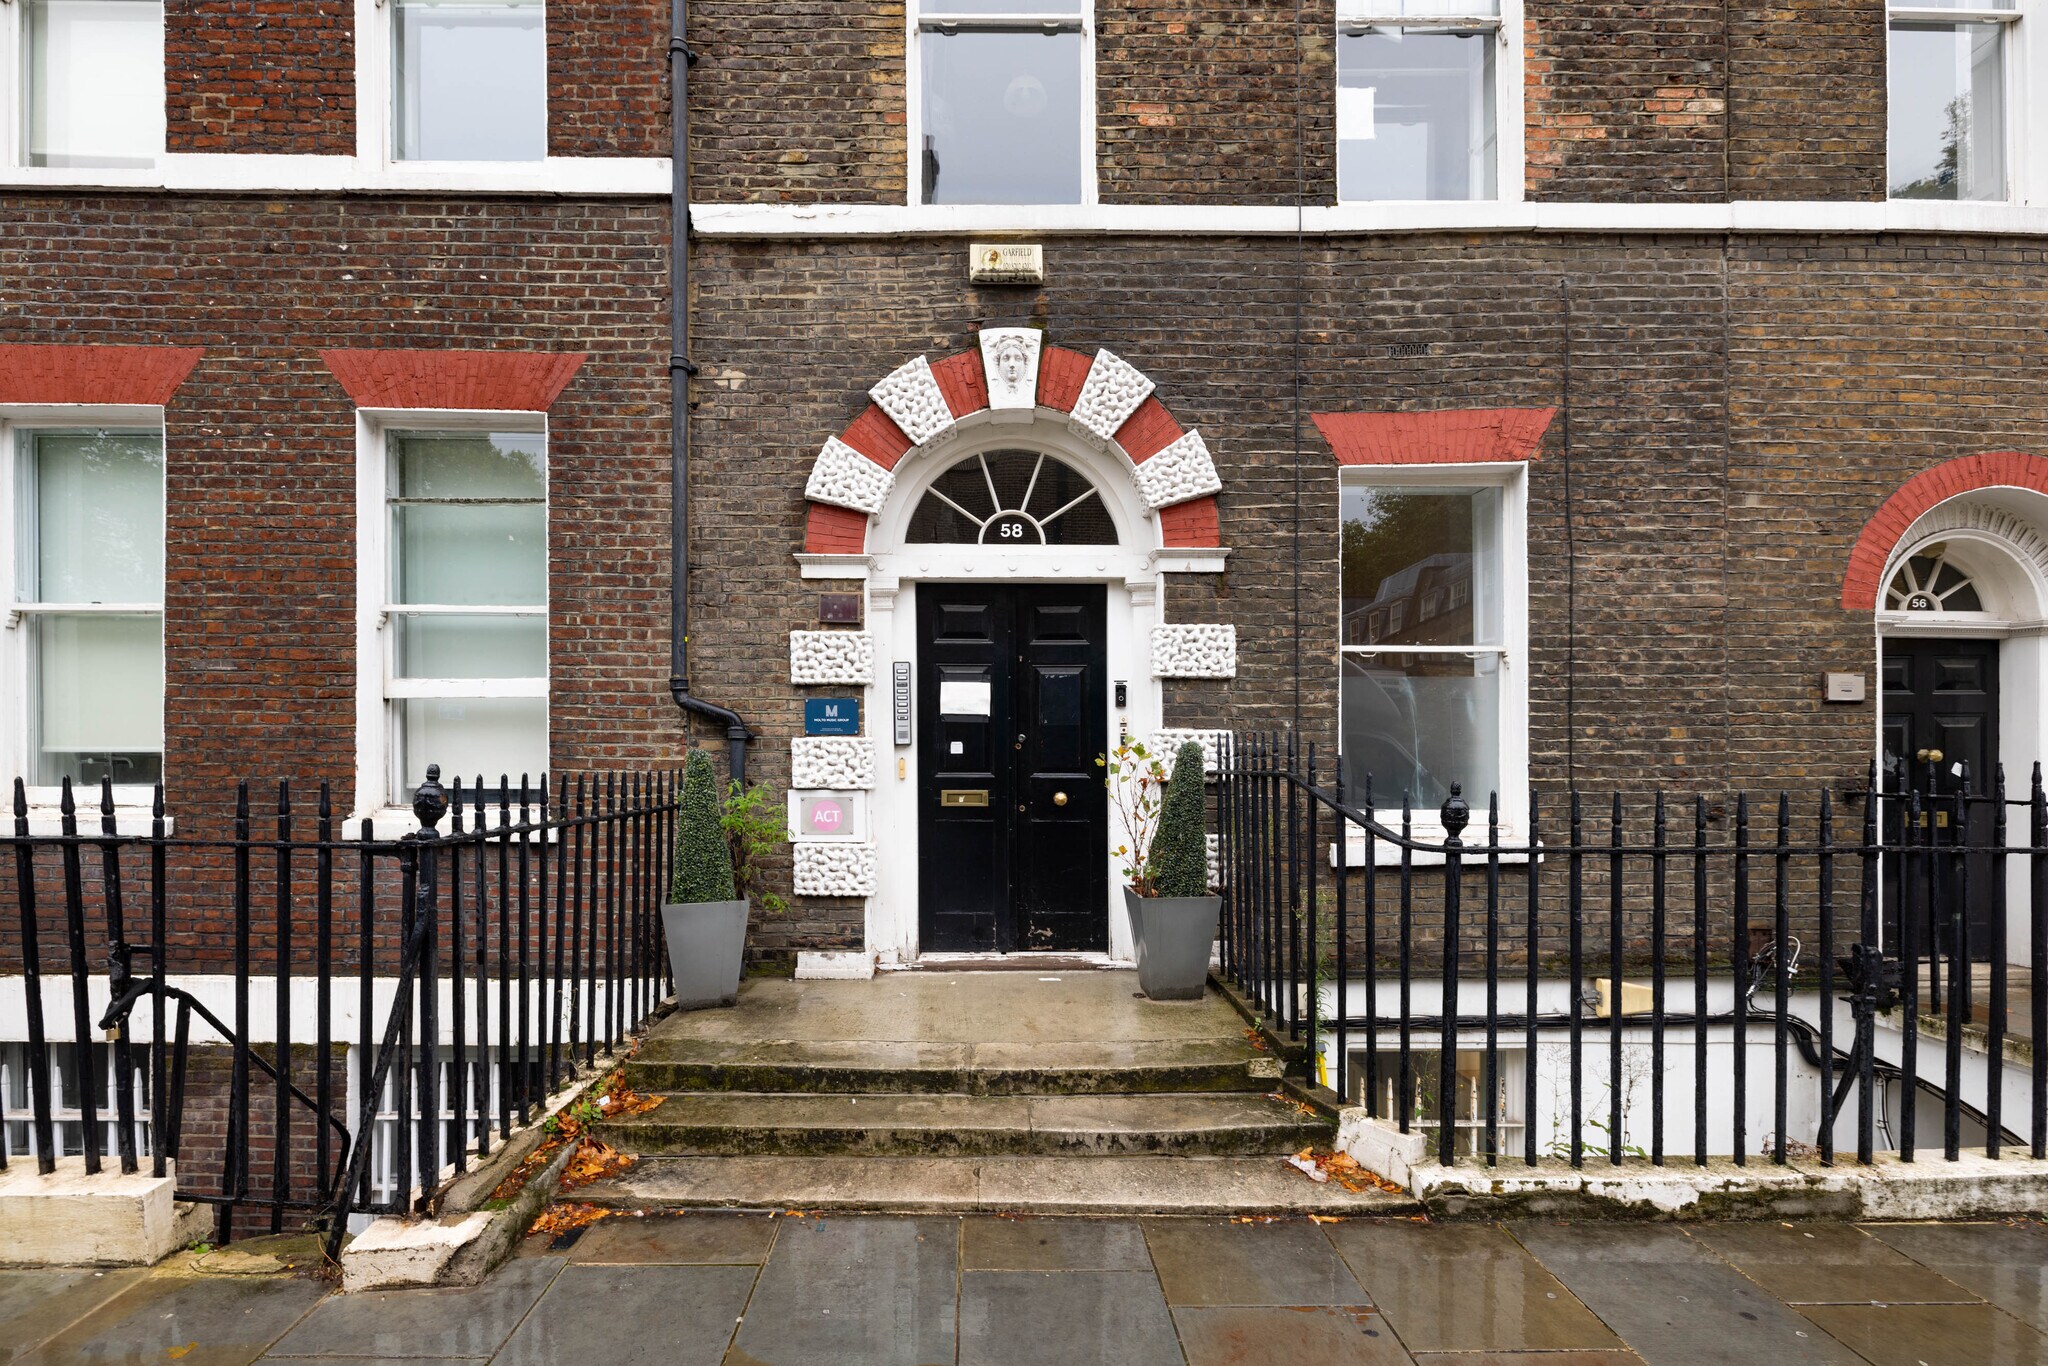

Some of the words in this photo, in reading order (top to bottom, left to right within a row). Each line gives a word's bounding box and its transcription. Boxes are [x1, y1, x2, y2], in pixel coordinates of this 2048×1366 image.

[1003, 248, 1032, 256] GARFIELD
[1000, 523, 1023, 538] 58
[1911, 598, 1927, 608] 56
[825, 704, 838, 717] M
[814, 810, 841, 823] ACT
